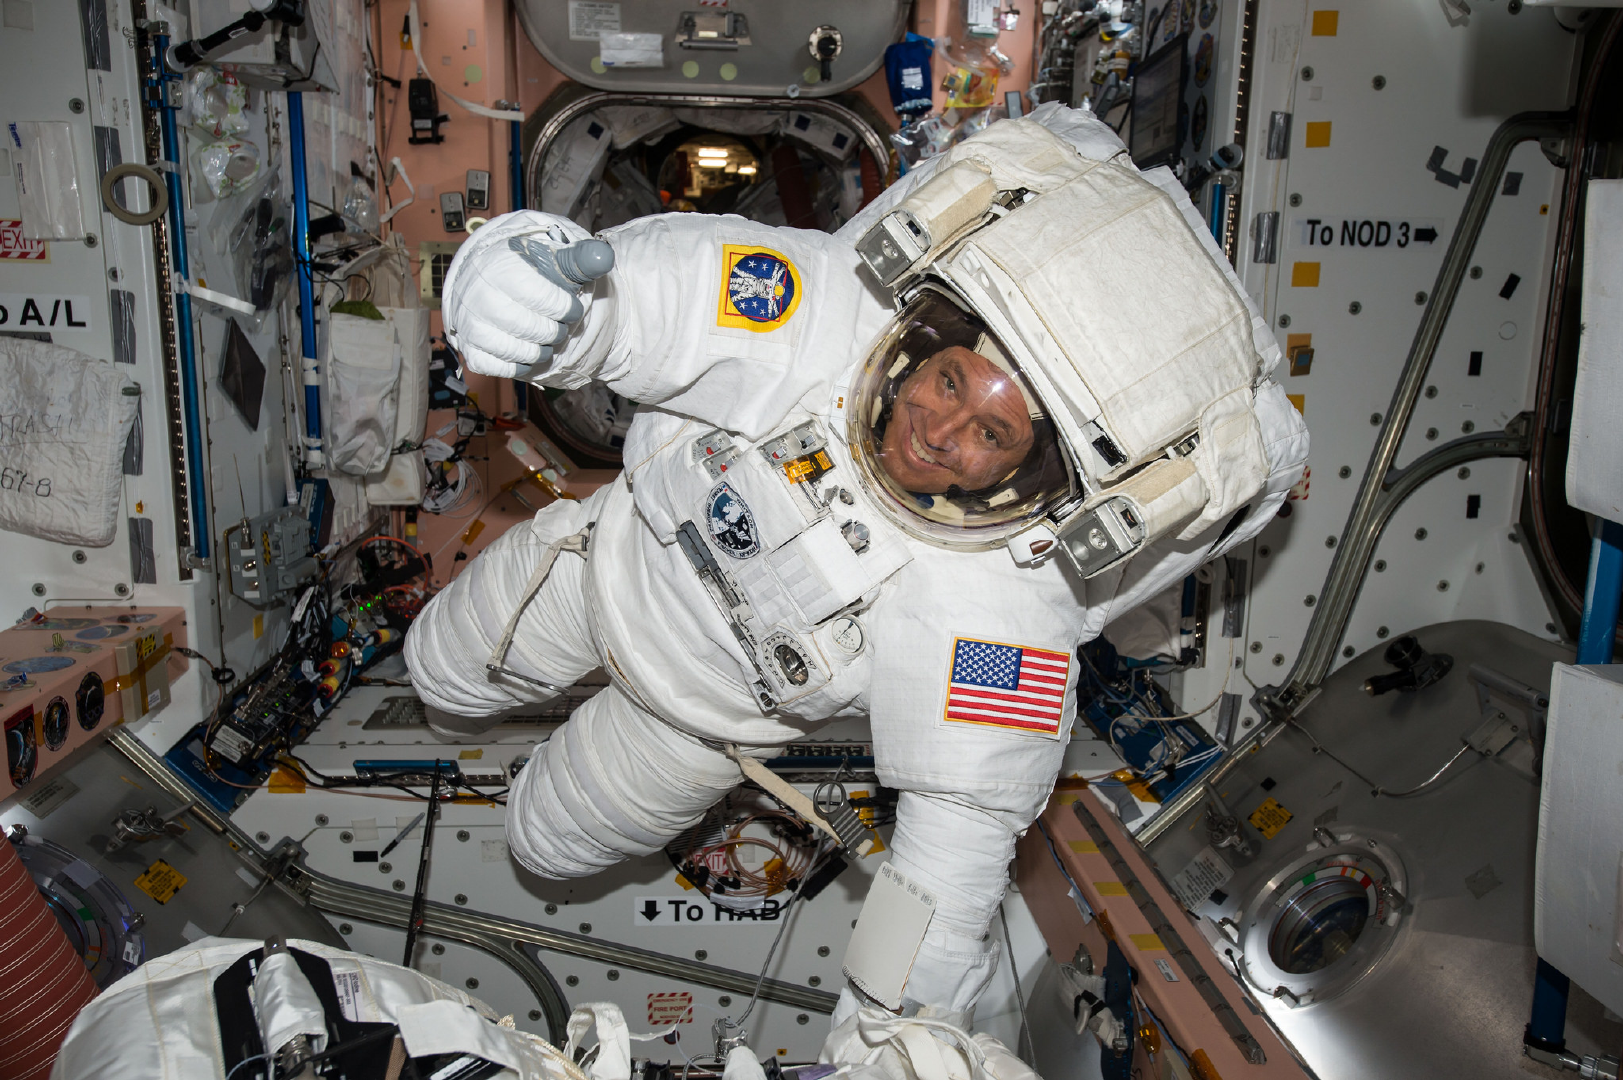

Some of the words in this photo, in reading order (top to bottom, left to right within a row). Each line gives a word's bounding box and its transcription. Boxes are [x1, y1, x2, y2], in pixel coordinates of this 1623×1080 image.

[1307, 219, 1333, 246] To
[1340, 220, 1391, 247] NOD
[1397, 222, 1410, 248] 3
[20, 298, 86, 327] A/L
[668, 900, 703, 922] To
